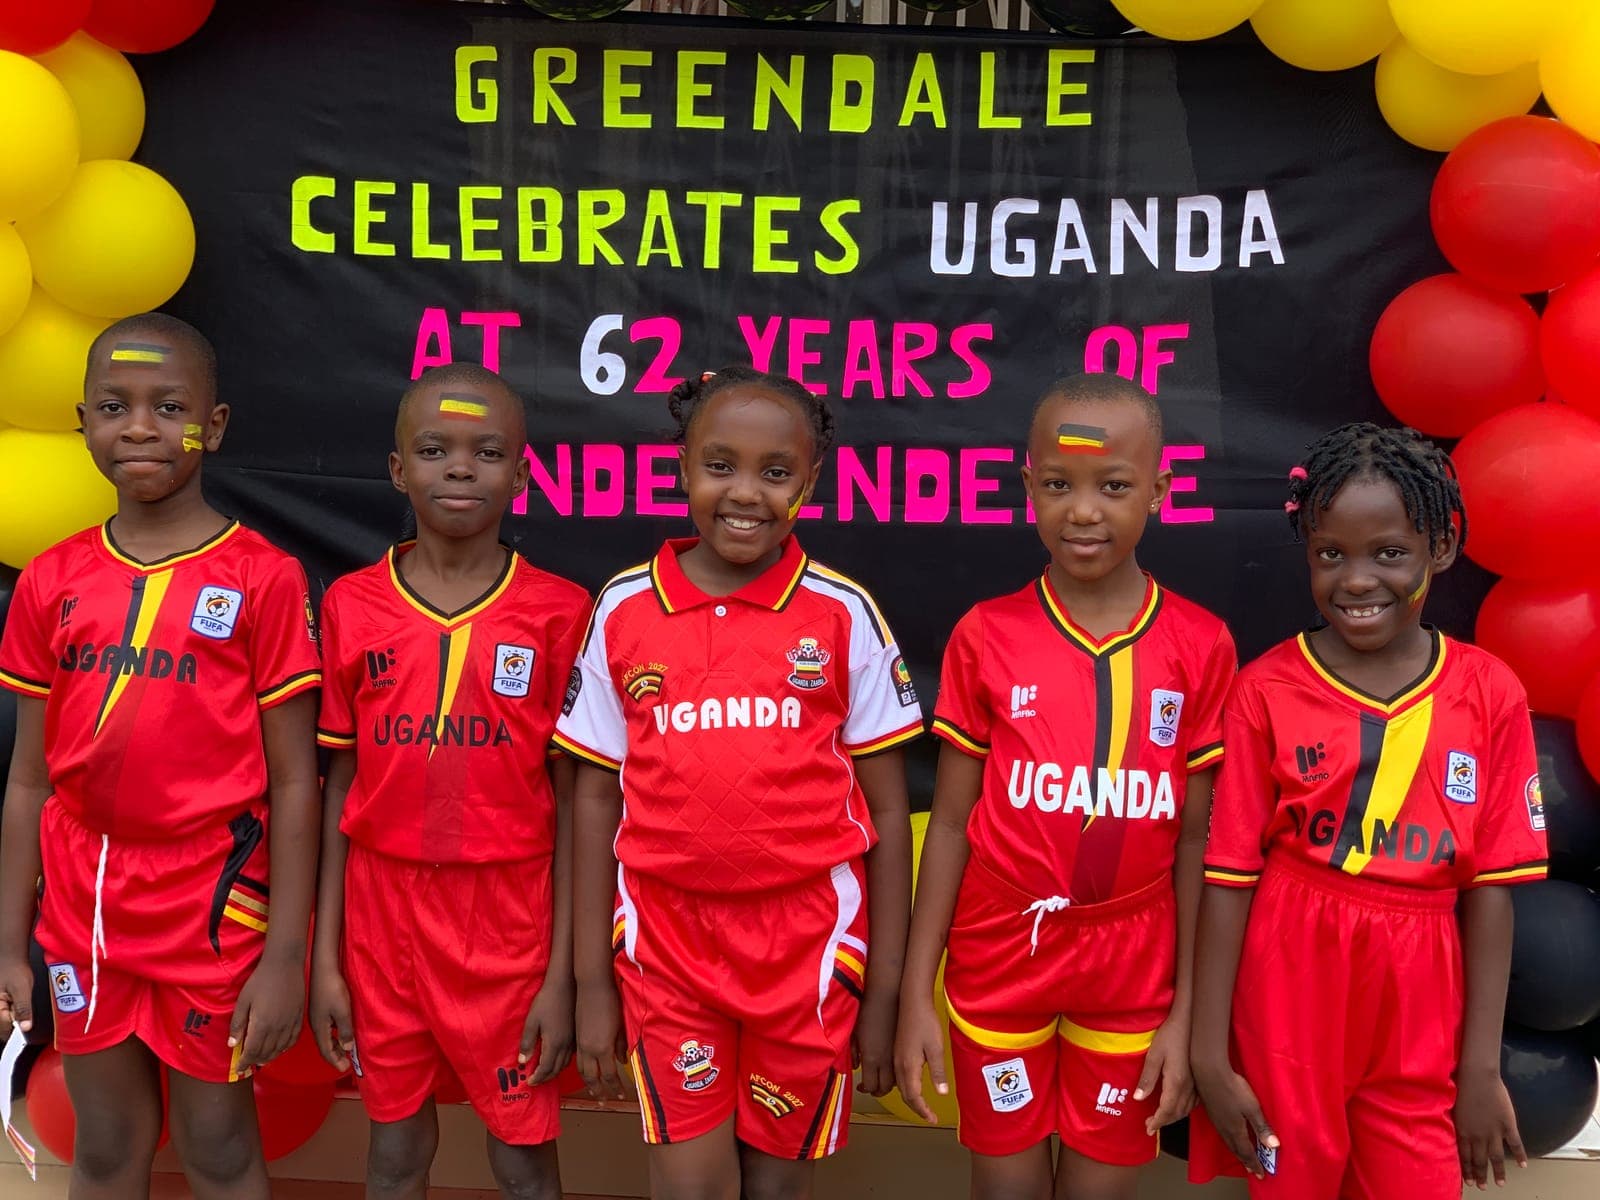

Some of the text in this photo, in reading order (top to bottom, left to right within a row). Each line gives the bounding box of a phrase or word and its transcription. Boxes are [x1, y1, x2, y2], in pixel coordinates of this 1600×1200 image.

[455, 46, 1096, 132] GREENDALE
[291, 176, 1285, 277] CELEBRATES UGANDA
[411, 307, 1190, 399] AT 62 YEARS OF
[511, 444, 1214, 524] NDENDEE
[200, 619, 223, 631] FUFA
[59, 643, 198, 684] UGANDA
[647, 661, 669, 673] 2027
[501, 679, 522, 689] FUFA
[373, 714, 513, 747] UGANDA
[653, 696, 801, 735] UGANDA
[1007, 759, 1176, 820] UGANDA
[1451, 787, 1471, 798] FUFA
[750, 1072, 781, 1093] AFCON
[1001, 1093, 1025, 1105] FUFA
